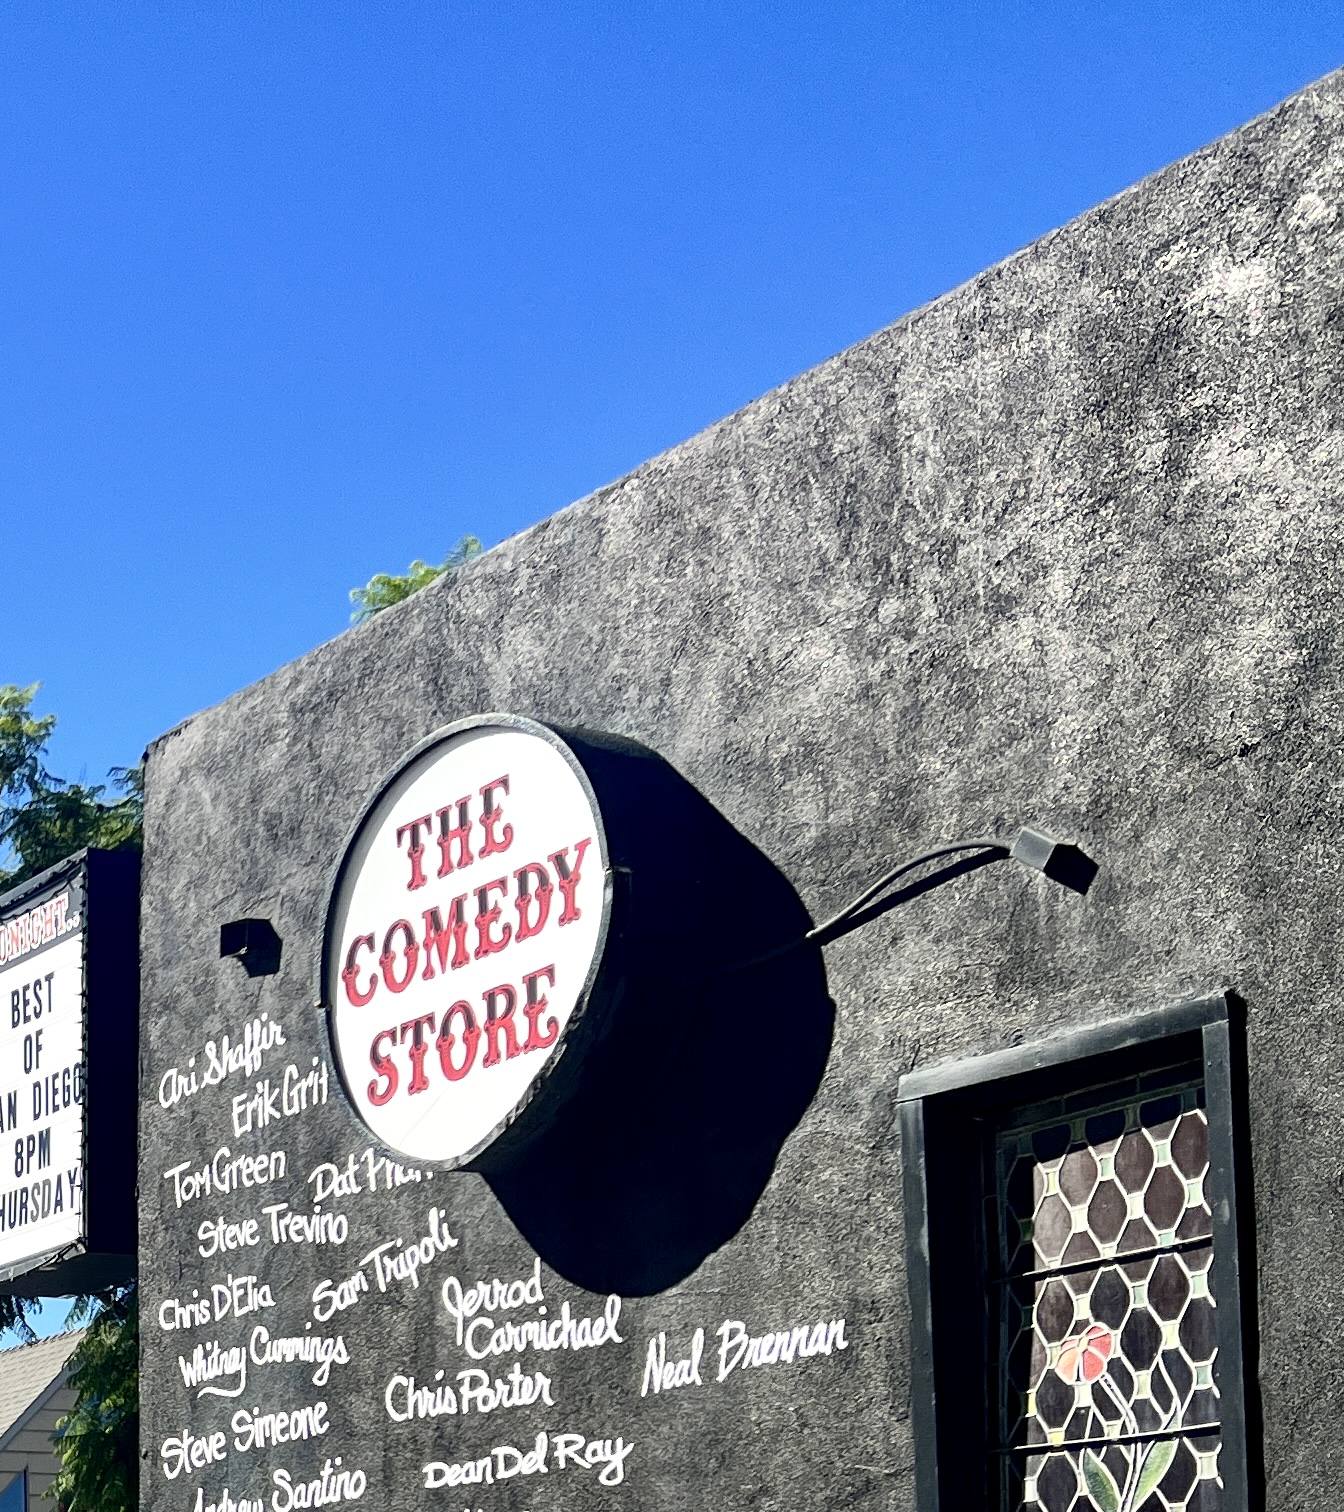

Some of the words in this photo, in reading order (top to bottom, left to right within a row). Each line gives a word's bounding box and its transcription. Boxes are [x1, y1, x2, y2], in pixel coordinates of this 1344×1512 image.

[396, 774, 514, 892] THE
[341, 837, 592, 1008] COMEDY
[11, 971, 55, 1029] BEST
[23, 1029, 43, 1074] OF
[200, 1012, 287, 1089] Shaffir
[367, 964, 560, 1107] STORE
[32, 1062, 83, 1121] DIEGO
[232, 1079, 282, 1138] Erik
[14, 1127, 51, 1178] 8PM
[212, 1147, 286, 1195] Green
[307, 1153, 363, 1203] Dat
[197, 1216, 260, 1258] Steve
[262, 1203, 348, 1246] Trevino
[313, 1271, 369, 1322] Sam
[360, 1207, 459, 1293] Tripoli
[159, 1290, 211, 1331] Chris
[211, 1274, 276, 1322] D'Elia
[442, 1257, 544, 1346] Jerrod
[465, 1293, 623, 1360] Carmichael
[179, 1340, 247, 1399] Whitney
[250, 1322, 351, 1387] Cummings
[641, 1327, 705, 1398] Neal
[716, 1319, 849, 1383] Brennan
[385, 1369, 458, 1423] Chris
[456, 1362, 555, 1414] Porter
[161, 1429, 227, 1480] Steve
[231, 1401, 330, 1452] Simeone
[422, 1455, 494, 1489] Dean
[491, 1432, 549, 1479] Del
[551, 1433, 635, 1486] Ray
